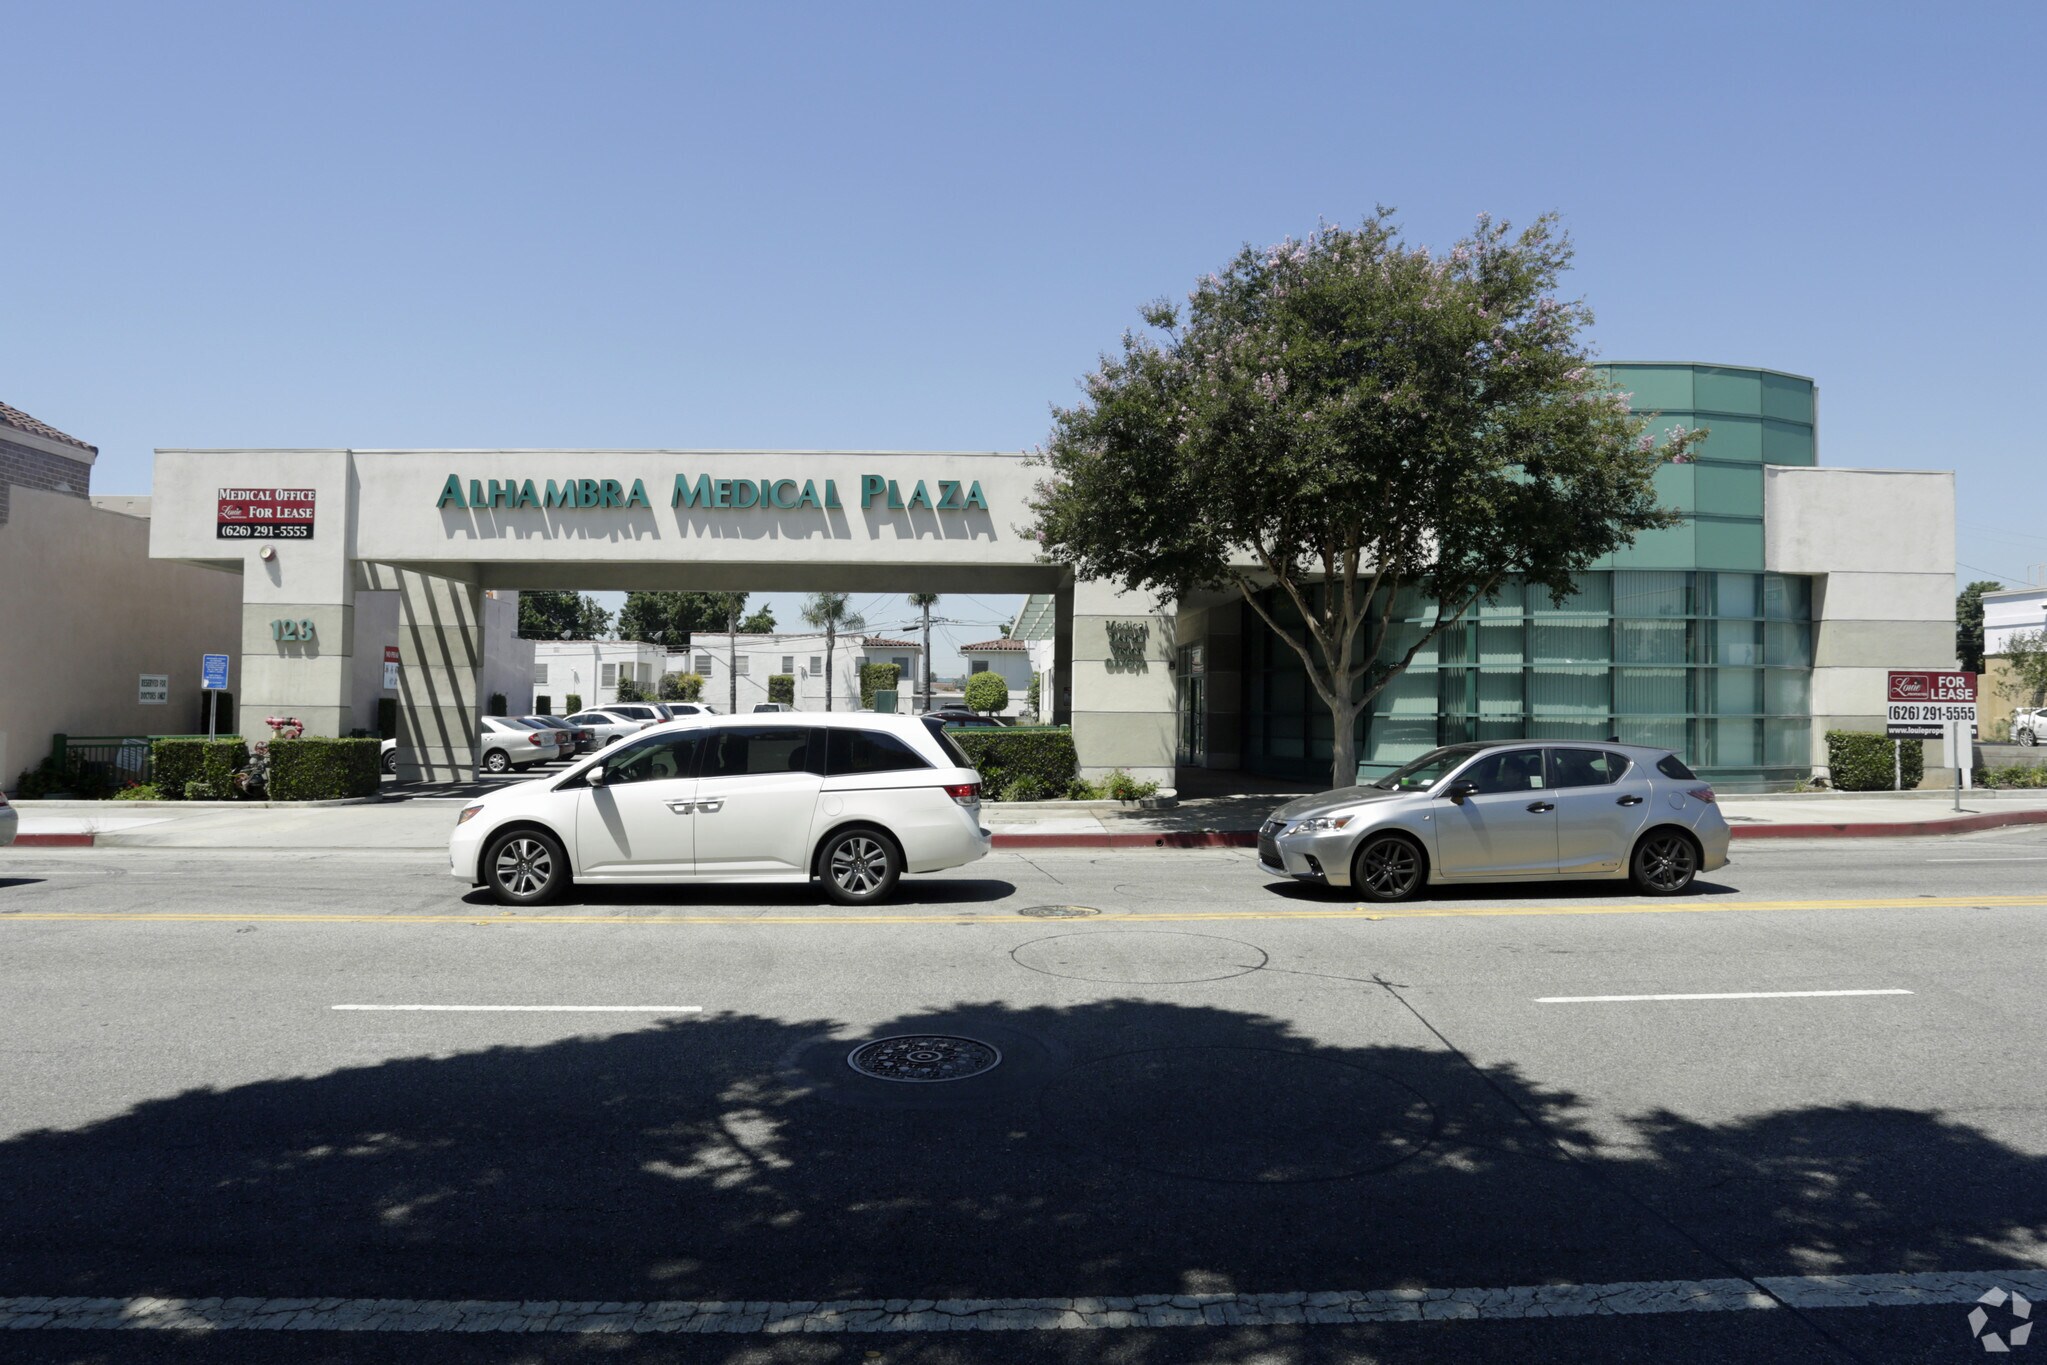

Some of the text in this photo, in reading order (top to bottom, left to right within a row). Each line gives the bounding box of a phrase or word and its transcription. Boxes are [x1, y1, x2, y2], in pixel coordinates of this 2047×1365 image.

[219, 488, 315, 500] MEDICAL OFFICE
[436, 473, 988, 509] ALHAMBRA MEDICAL PLAZA
[249, 506, 313, 518] FOR LEASE
[221, 525, 307, 536] (626) 291-5555
[271, 619, 314, 641] 123
[1938, 676, 1966, 688] FOR
[1930, 688, 1973, 700] LEASE
[1889, 706, 1975, 720] (626) 291-5555
